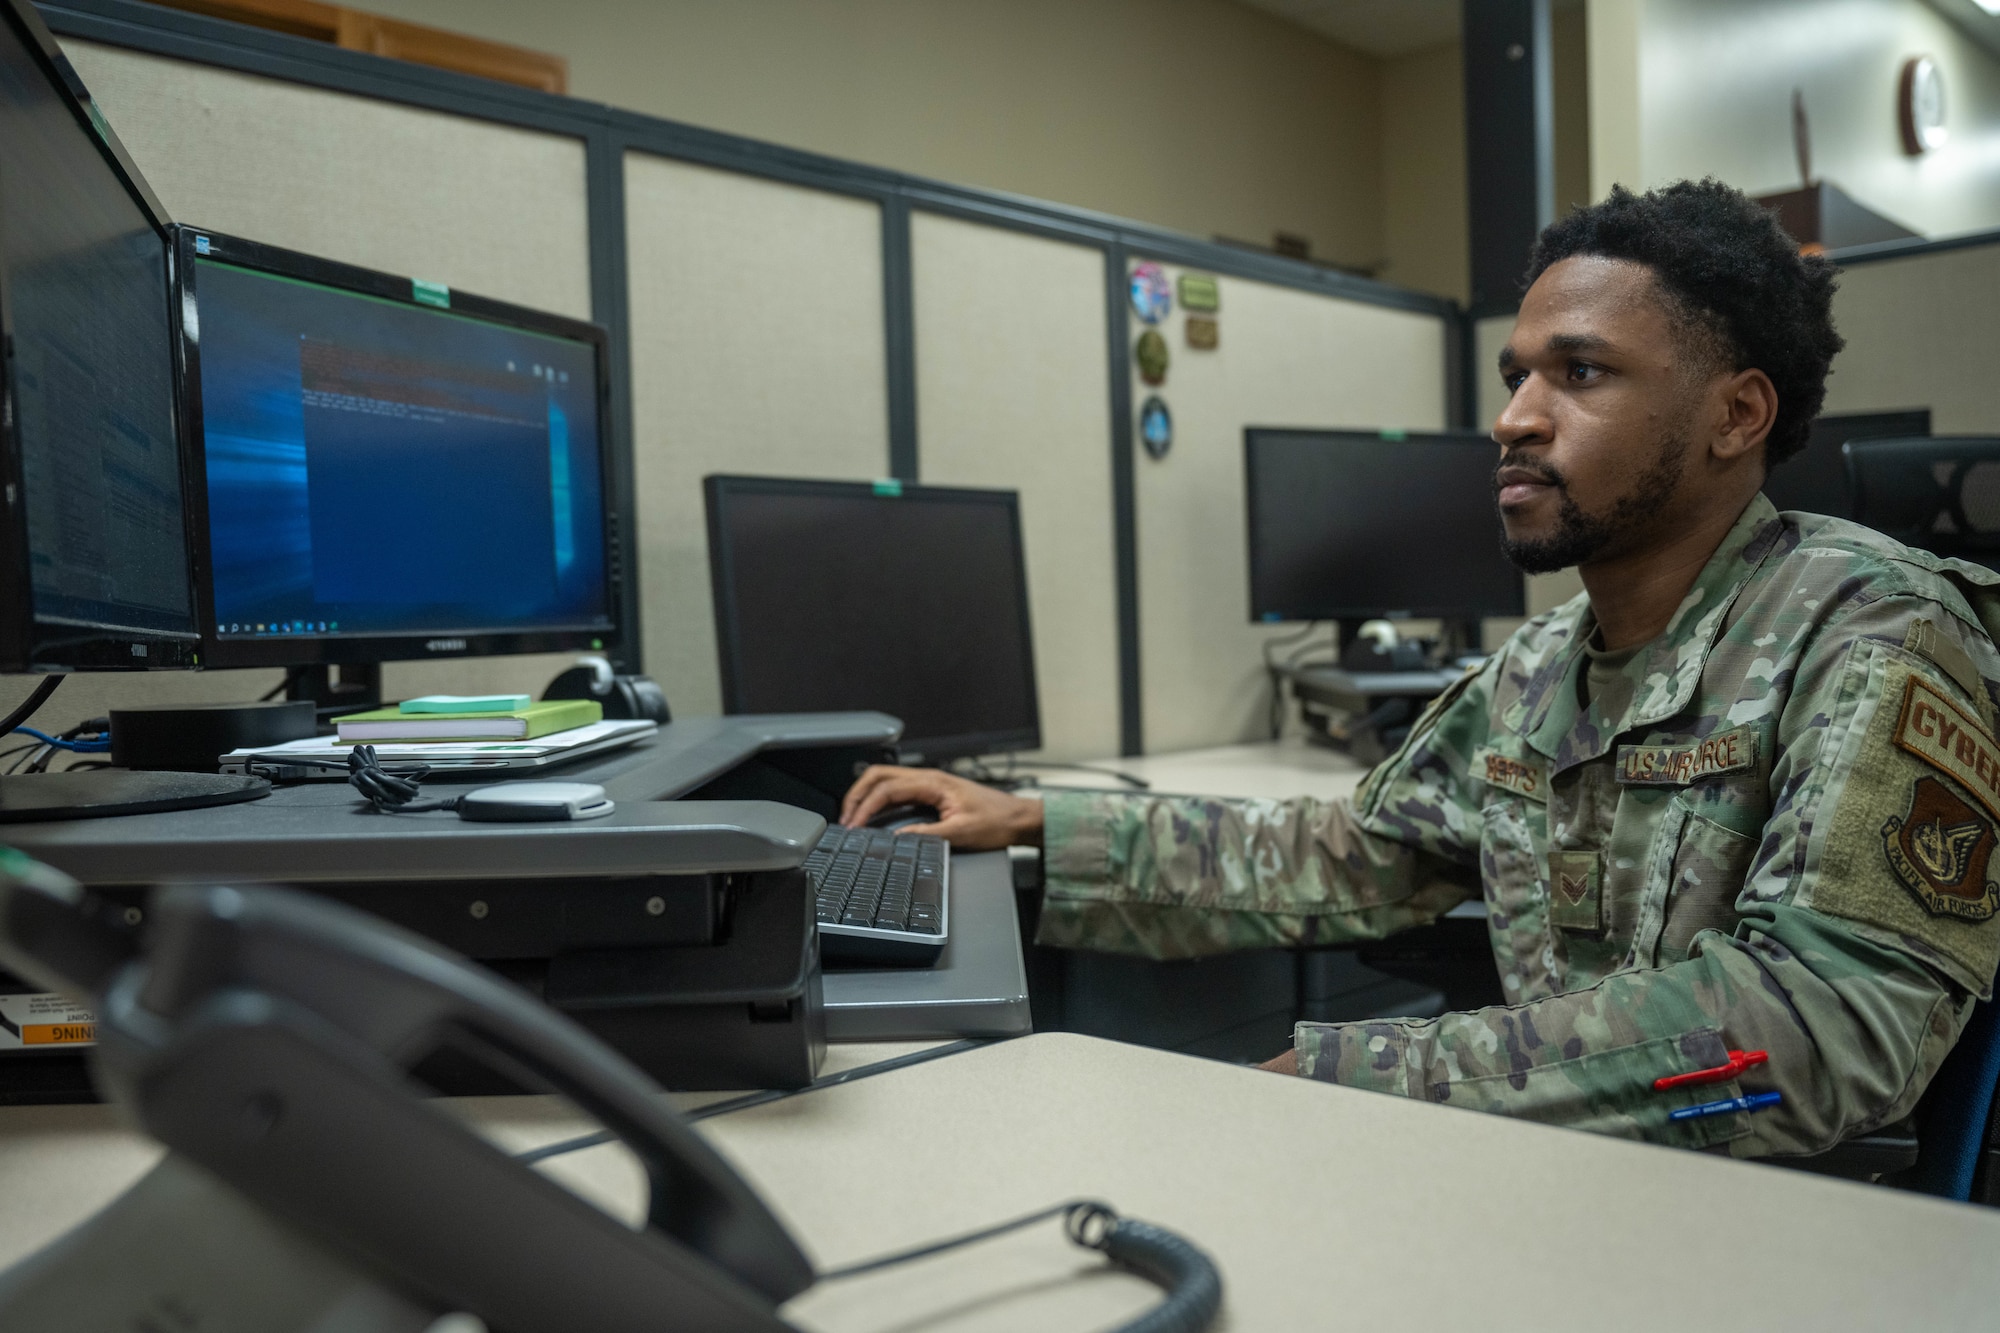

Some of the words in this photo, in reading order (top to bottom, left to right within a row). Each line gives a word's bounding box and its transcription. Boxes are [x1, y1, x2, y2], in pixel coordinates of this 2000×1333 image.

[1660, 752, 1693, 781] AIR
[1693, 734, 1738, 773] ORCE
[1889, 847, 1927, 888] PACIFIC
[1925, 892, 1945, 910] AIR
[1949, 898, 1988, 917] FORCES
